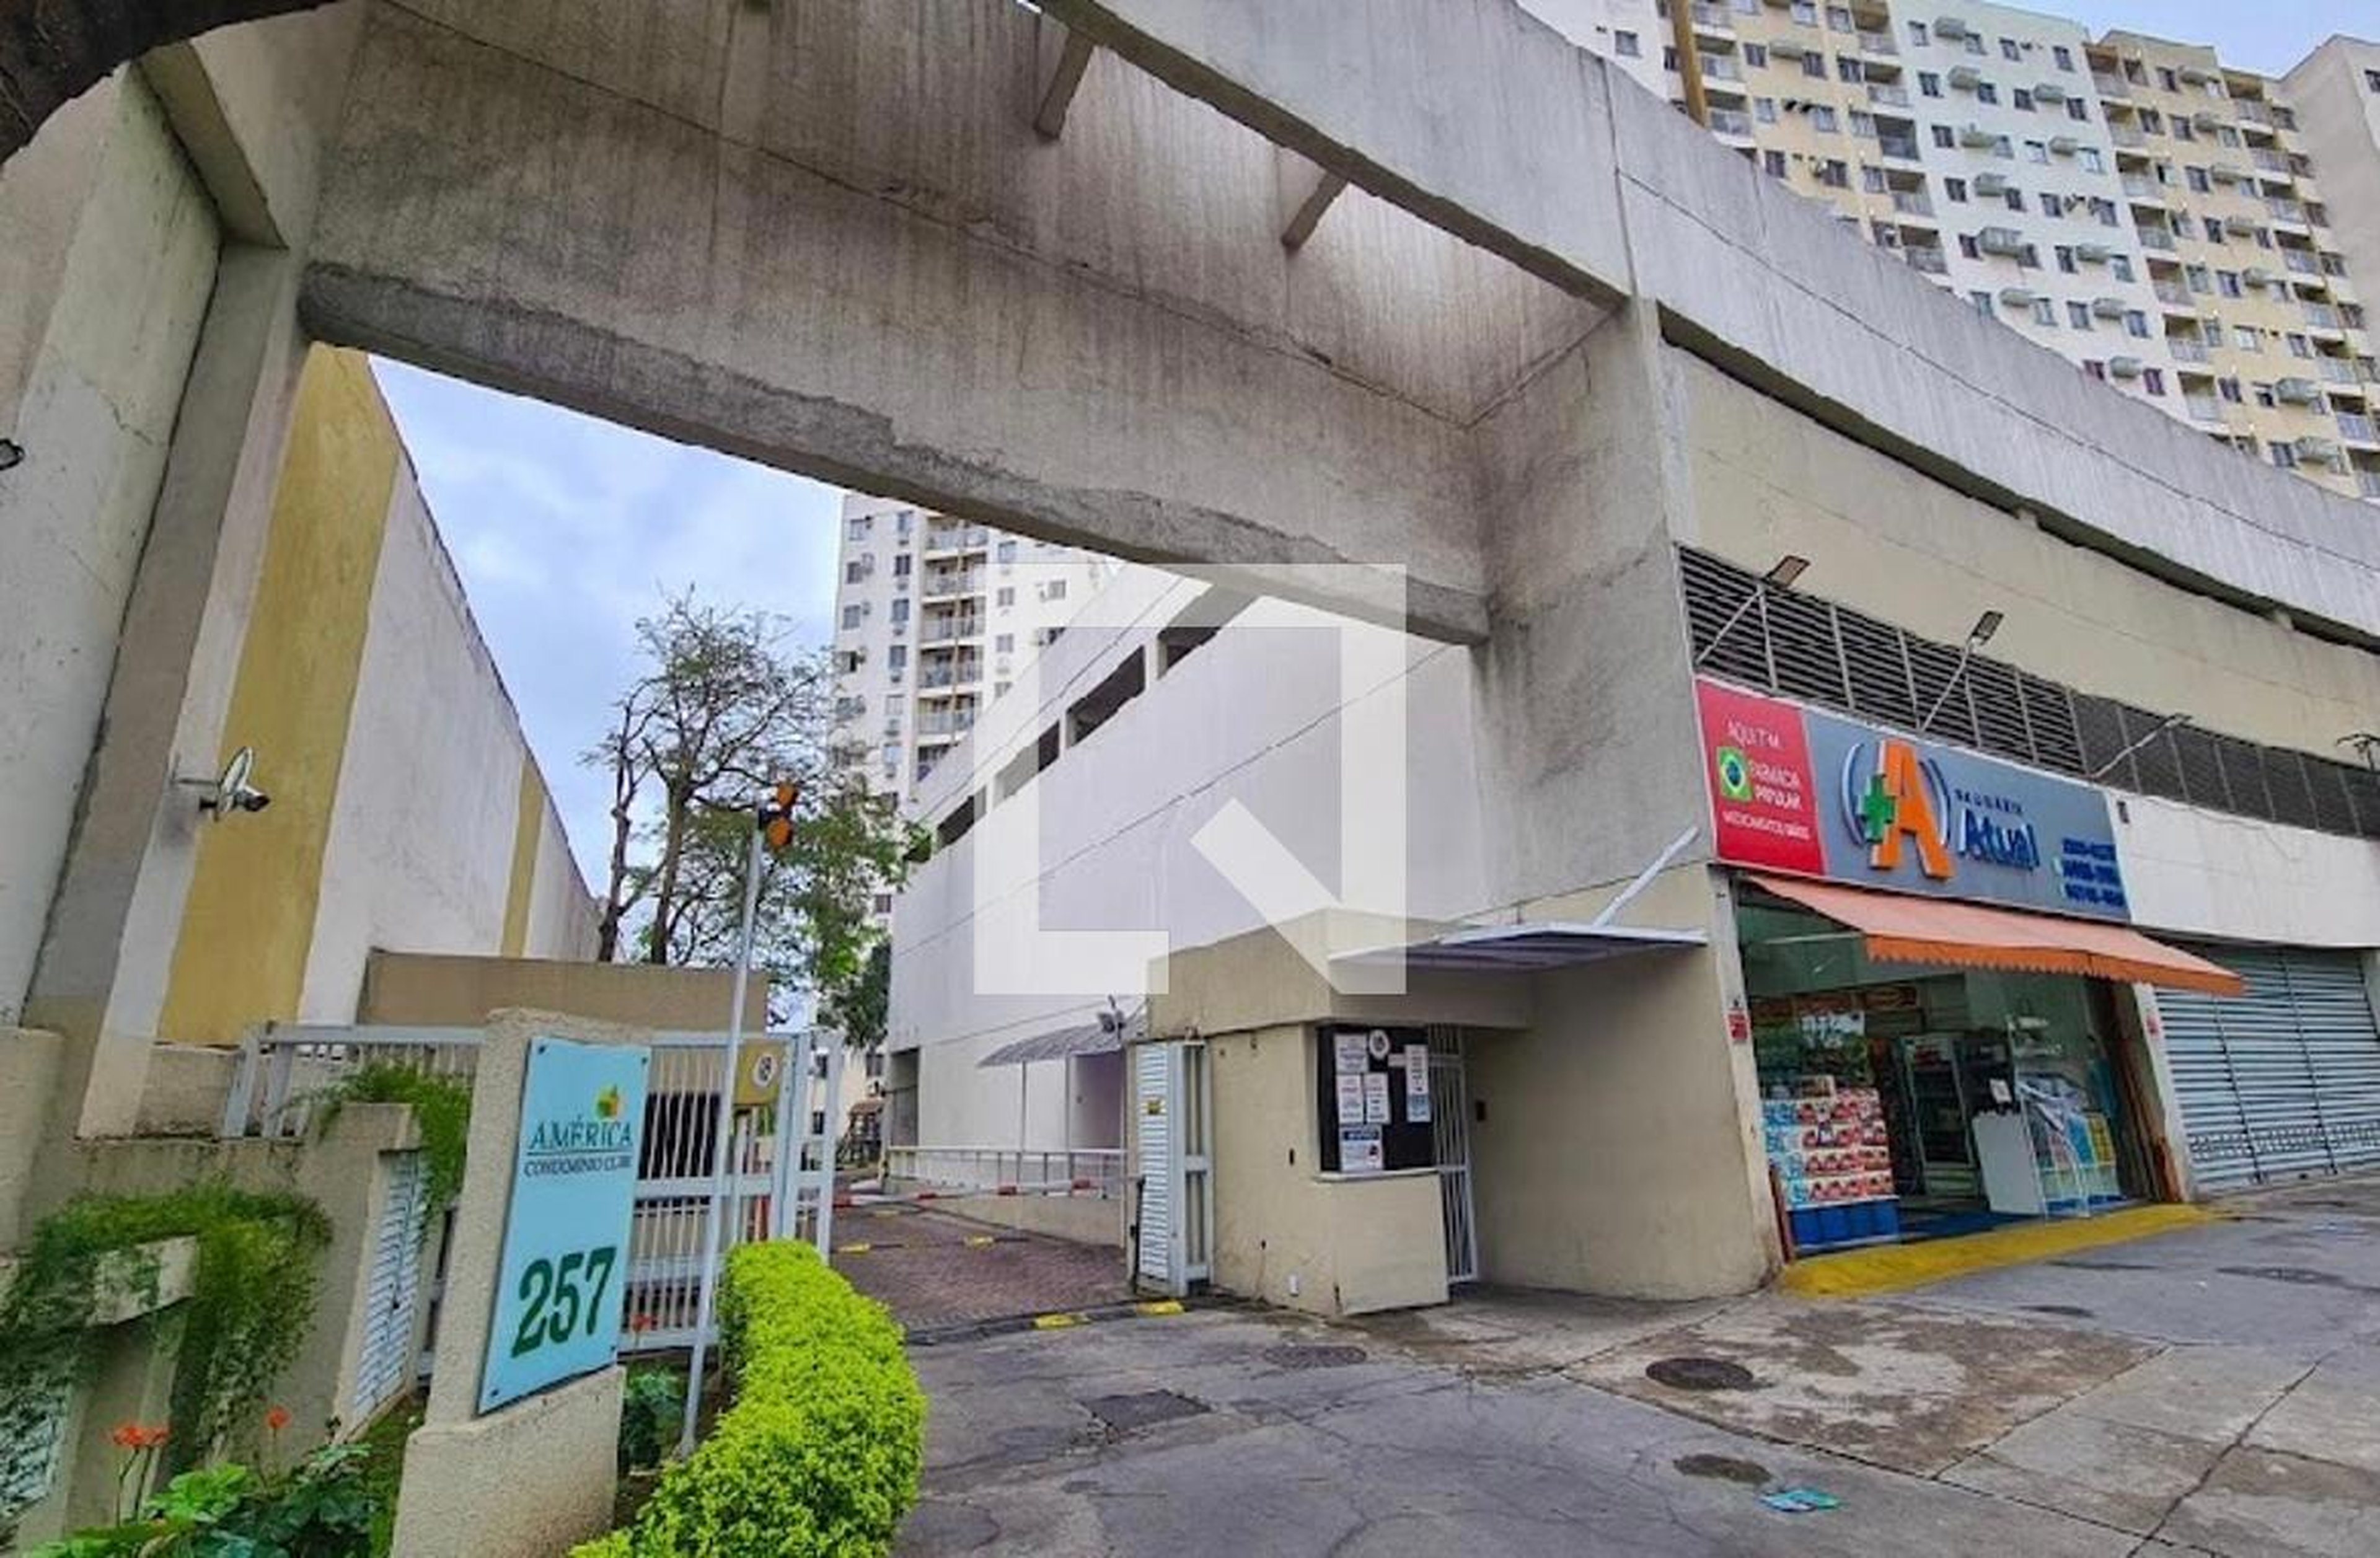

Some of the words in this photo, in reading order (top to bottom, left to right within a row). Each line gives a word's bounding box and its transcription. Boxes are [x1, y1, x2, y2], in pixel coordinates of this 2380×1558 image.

[1957, 808, 2040, 871] Atual
[528, 1114, 633, 1150] AMÉRICA
[511, 1246, 617, 1358] 257
